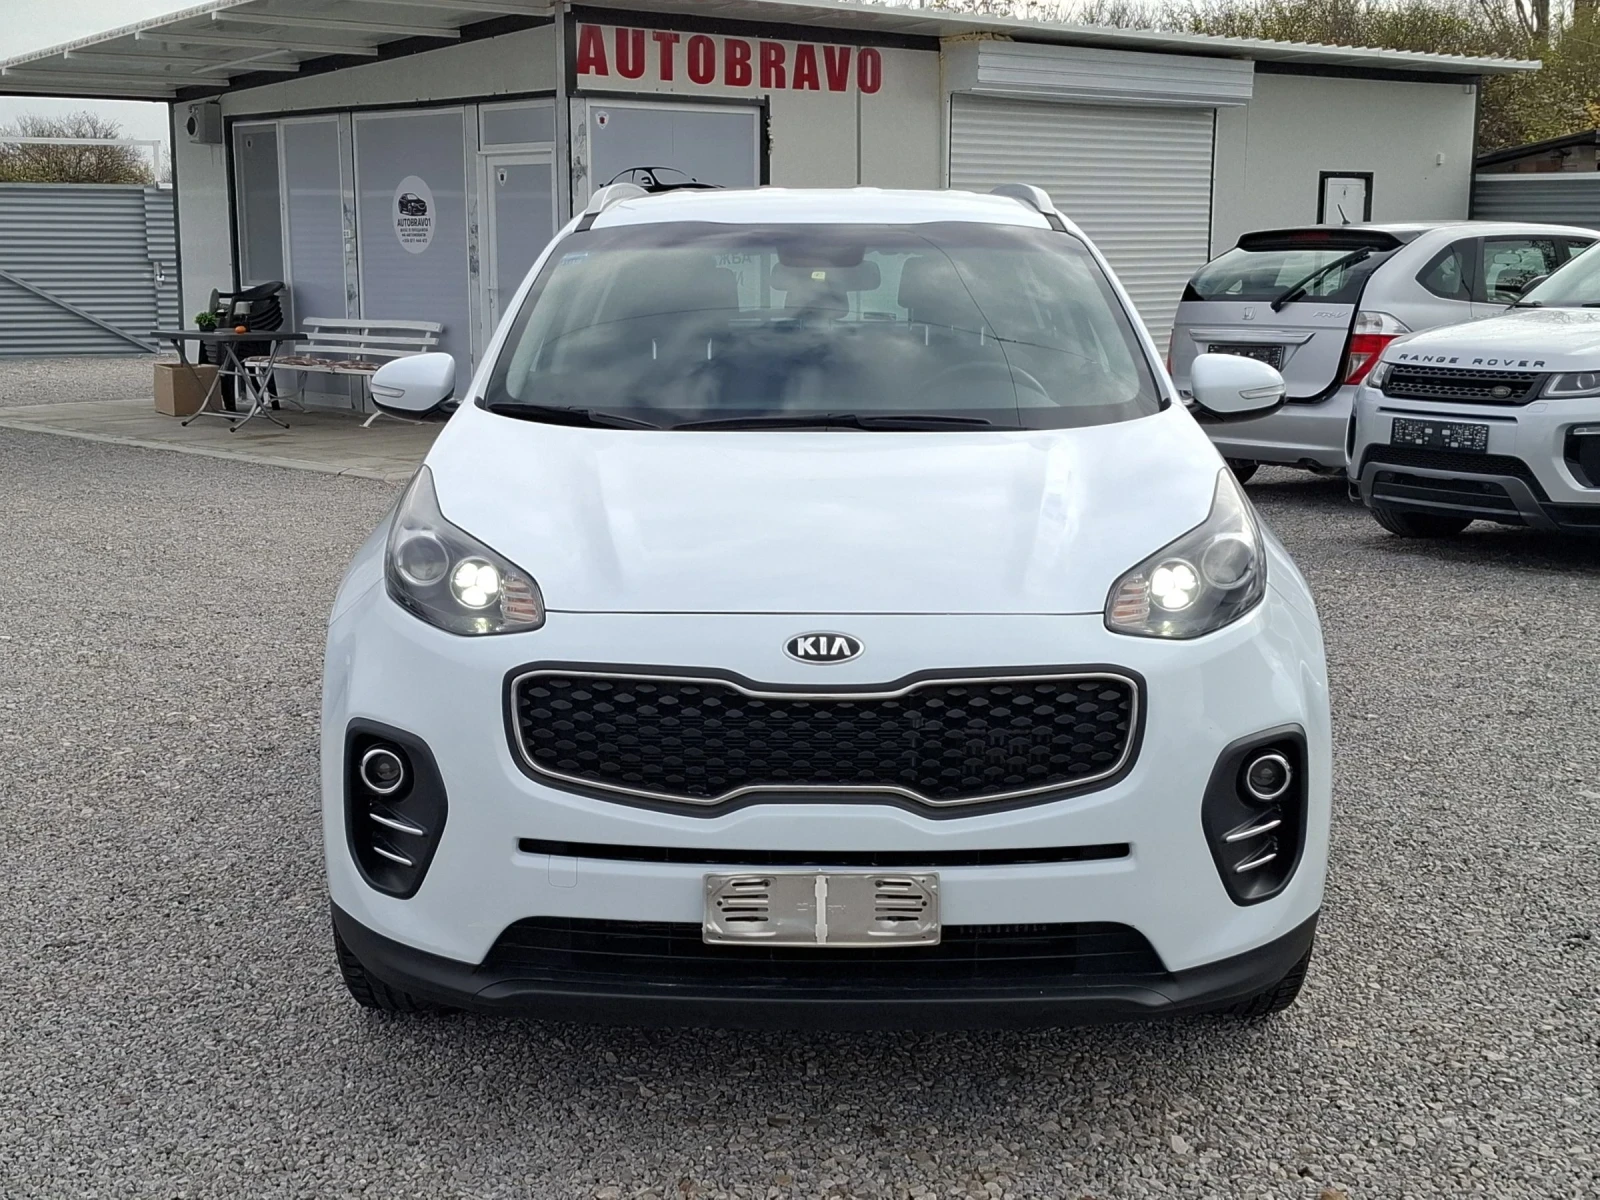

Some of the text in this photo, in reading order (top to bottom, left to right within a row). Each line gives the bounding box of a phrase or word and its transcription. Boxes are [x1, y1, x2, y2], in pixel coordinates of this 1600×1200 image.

[576, 24, 882, 95] AUTOBRAVO
[397, 218, 431, 227] AUTOBRAVO1
[1398, 353, 1546, 369] RANGE ROVER
[796, 636, 851, 656] KIA
